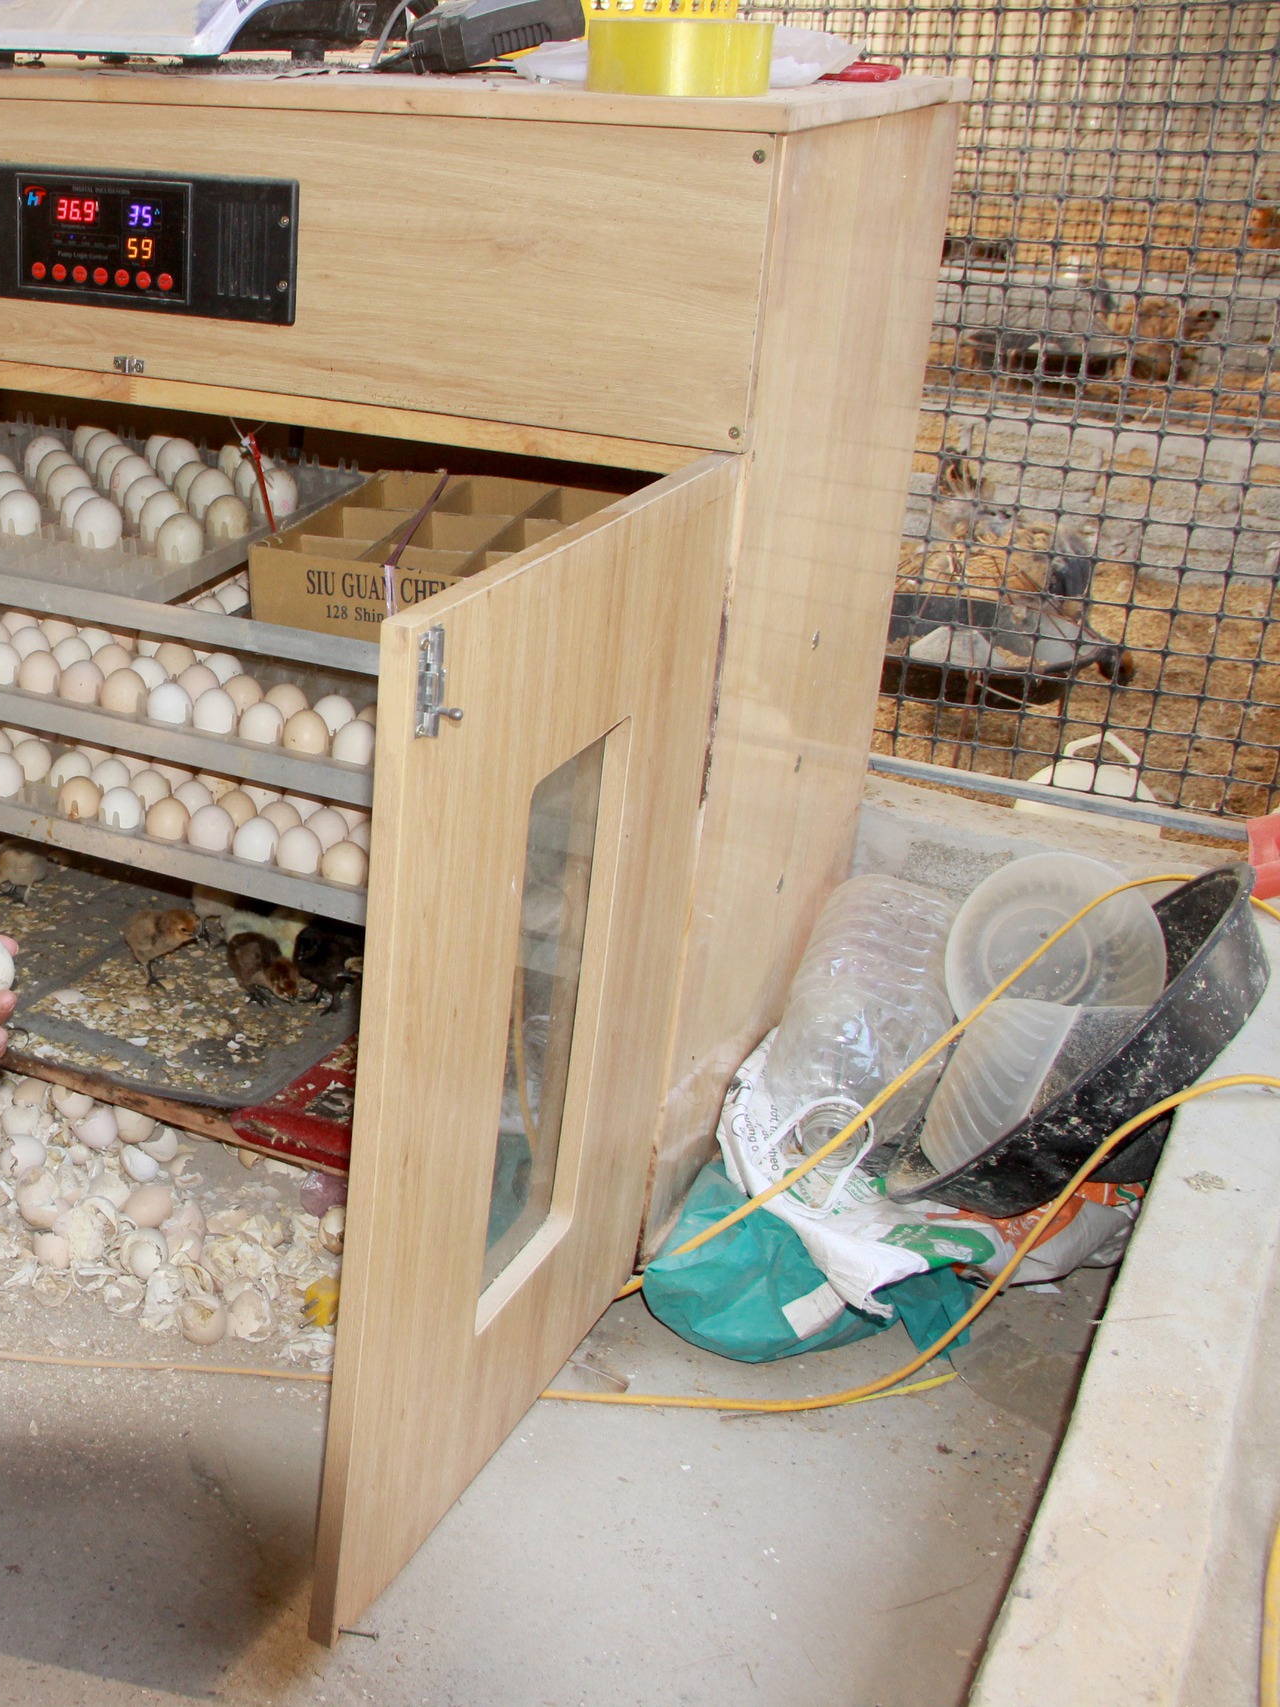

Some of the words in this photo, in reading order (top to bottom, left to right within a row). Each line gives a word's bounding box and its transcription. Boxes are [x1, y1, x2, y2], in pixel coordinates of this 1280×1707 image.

[57, 199, 94, 222] 36.9
[128, 204, 153, 228] 35
[127, 237, 153, 260] 59
[306, 569, 335, 596] SIU
[326, 604, 348, 620] 128
